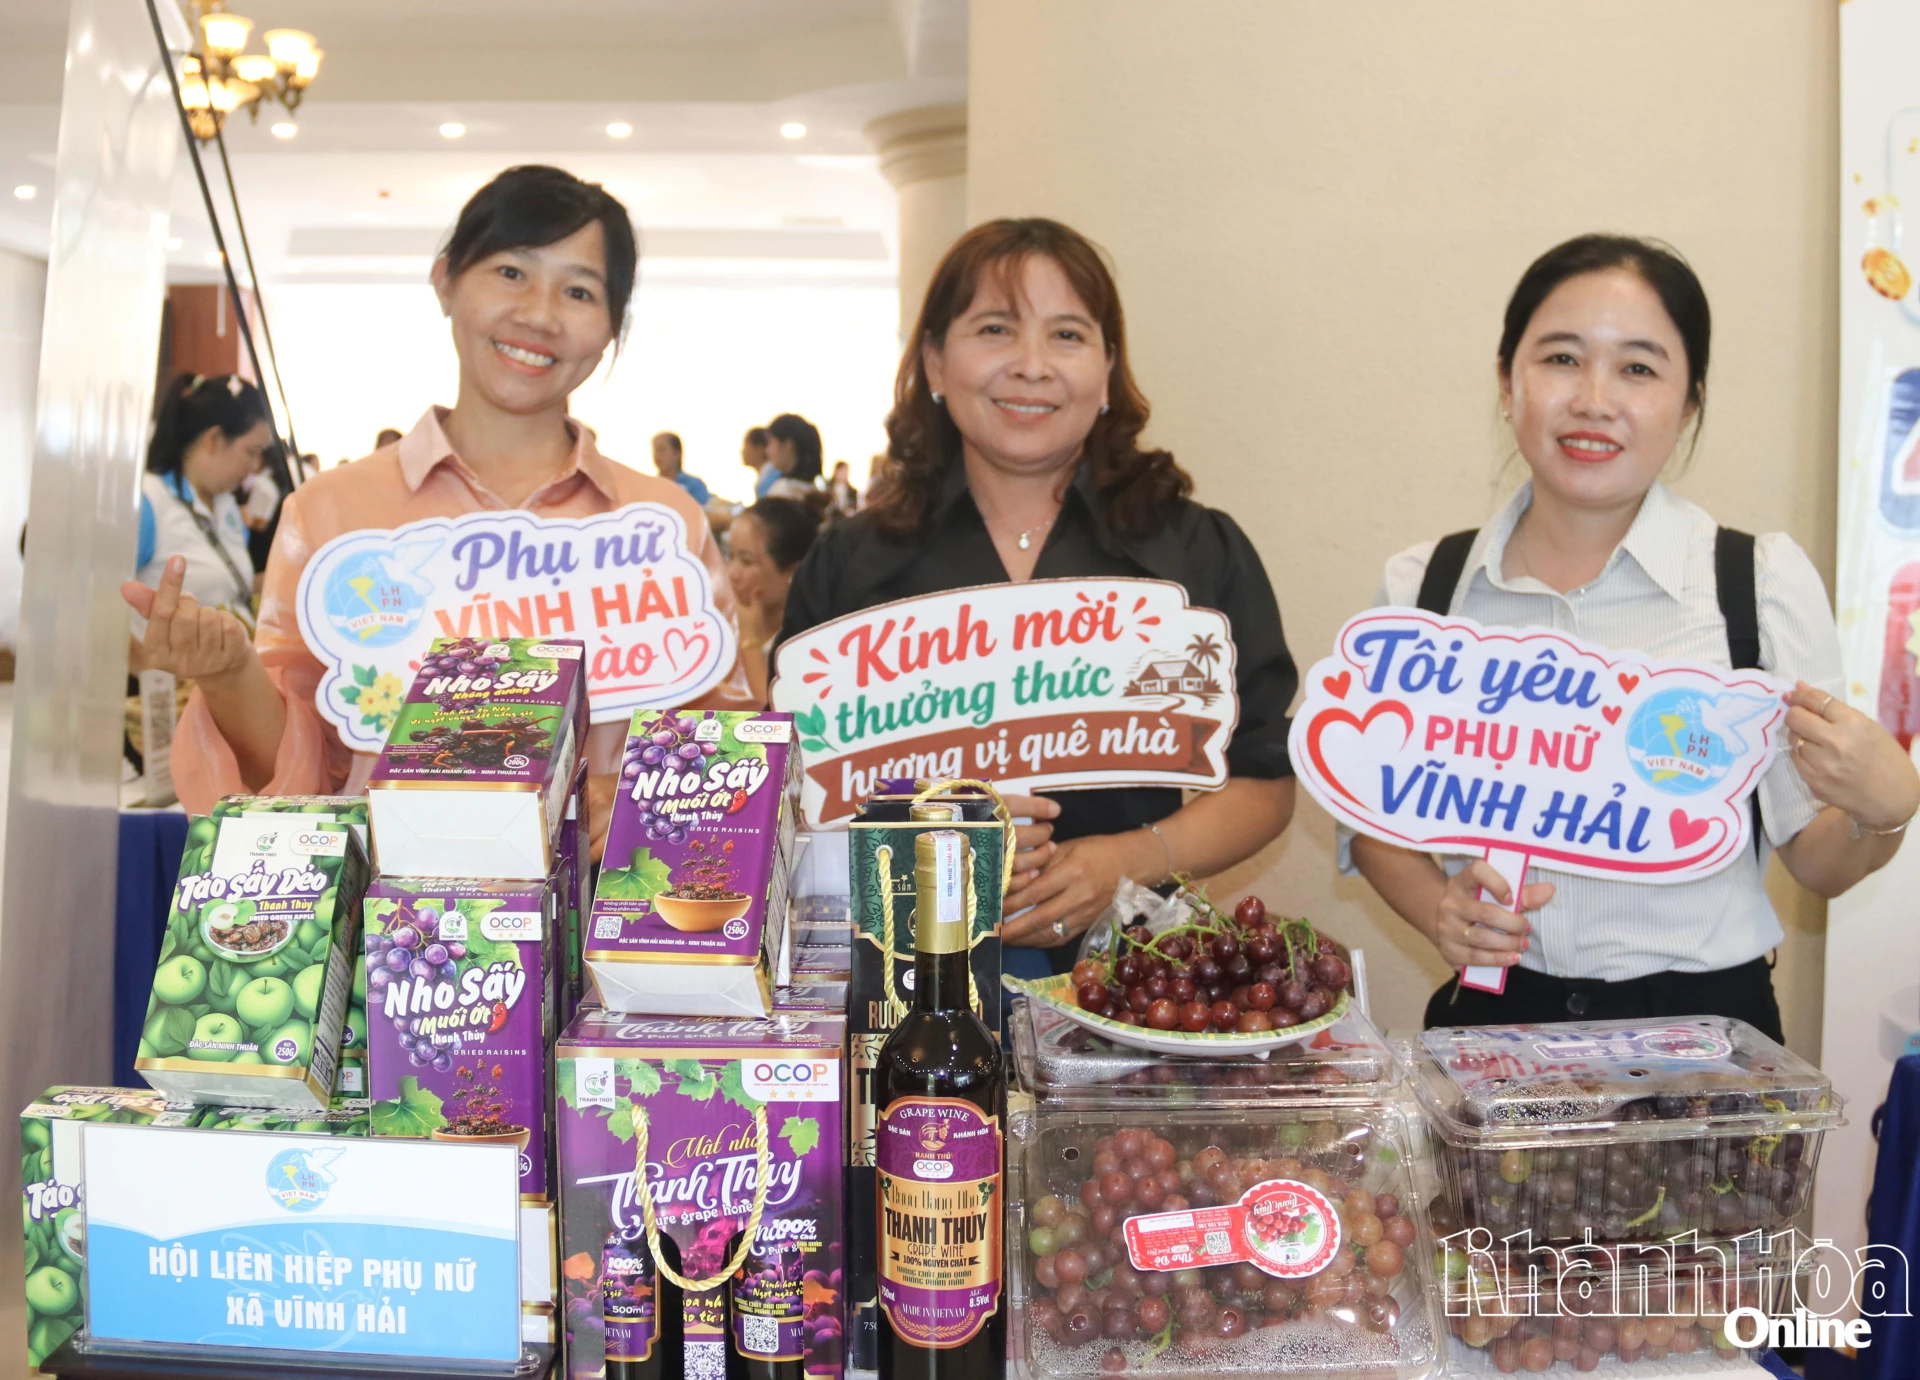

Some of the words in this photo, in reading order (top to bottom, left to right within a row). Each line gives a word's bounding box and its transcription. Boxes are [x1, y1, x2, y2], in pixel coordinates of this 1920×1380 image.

[451, 530, 580, 593] Phụ
[596, 523, 667, 569] nữ
[434, 590, 577, 639] VĨNH
[591, 568, 690, 628] HẢI
[838, 603, 997, 688] Kính
[1011, 590, 1124, 650] mời
[588, 633, 660, 681] ào
[1353, 629, 1463, 694] Tôi
[1477, 649, 1602, 714] yêu
[423, 676, 492, 696] Nho
[493, 669, 559, 692] Sấy
[452, 690, 490, 700] Không
[493, 687, 531, 697] đường
[834, 678, 996, 743] thưởng
[1011, 656, 1115, 704] thức
[743, 724, 782, 733] OCOP
[1424, 714, 1518, 772] PHỤ
[1528, 724, 1602, 773] NỮ
[841, 744, 963, 803] hương
[975, 729, 1012, 776] vị
[1018, 717, 1091, 766] quê
[1098, 714, 1180, 756] nhà
[1679, 761, 1704, 776] NAM
[631, 768, 701, 801] Nho
[703, 758, 770, 796] Sấy
[660, 792, 710, 815] Muối
[710, 788, 732, 808] Ớt
[1380, 759, 1527, 832] VĨNH
[1532, 782, 1652, 853] HẢI
[670, 810, 699, 822] Thanh
[701, 809, 723, 822] Thủy
[299, 834, 338, 846] OCOP
[180, 871, 227, 910] Táo
[226, 859, 279, 904] Sấy
[277, 864, 328, 896] Dẻo
[259, 901, 287, 911] Thanh
[291, 899, 313, 912] Thủy
[490, 917, 532, 928] OCOP
[727, 925, 745, 935] 250G
[384, 976, 455, 1018] Nho
[458, 962, 526, 1010] Sấy
[419, 1008, 467, 1036] Muối
[470, 1002, 491, 1026] Ớt
[189, 1039, 204, 1048] ĐẶC
[204, 1040, 217, 1049] SẢN
[219, 1042, 235, 1050] NINH
[236, 1043, 258, 1052] THUẬN
[430, 1032, 460, 1045] Thanh
[462, 1031, 486, 1044] Thủy
[277, 1047, 294, 1056] 250G
[754, 1063, 828, 1082] OCOP
[899, 1107, 936, 1119] GRAPE
[938, 1108, 970, 1122] WINE
[898, 1127, 911, 1136] SẢN
[953, 1129, 976, 1139] KHÁNH
[976, 1127, 989, 1136] HÒA
[661, 1123, 740, 1169] Mật
[912, 1151, 935, 1159] THANH
[916, 1161, 950, 1171] OCOP
[29, 1178, 73, 1219] Táo
[300, 1191, 315, 1199] NAM
[576, 1160, 716, 1240] Thanh
[656, 1215, 676, 1226] ure
[681, 1209, 719, 1226] grape
[723, 1202, 755, 1217] hone
[772, 1218, 817, 1233] 100%
[885, 1206, 937, 1245] THANH
[941, 1211, 987, 1245] THỦY
[907, 1243, 936, 1258] GRAPE
[941, 1244, 964, 1258] WINE
[1169, 1251, 1194, 1263] Nho
[149, 1242, 199, 1284] HỘI
[210, 1245, 273, 1283] LIÊN
[284, 1247, 354, 1293] HIỆP
[363, 1258, 422, 1296] PHỤ
[434, 1256, 477, 1293] NỮ
[608, 1257, 643, 1270] 100%
[903, 1255, 922, 1266] 100%
[923, 1256, 949, 1268] NGUYÊN
[950, 1256, 967, 1267] CHẤT
[1153, 1255, 1170, 1268] Đỏ
[752, 1287, 773, 1299] Ngọt
[881, 1284, 896, 1301] 750ml
[969, 1294, 990, 1308] 8.5Vol
[226, 1290, 263, 1327] XÃ
[273, 1294, 345, 1333] VĨNH
[356, 1294, 407, 1335] HẢI
[612, 1305, 644, 1314] 500ml
[902, 1303, 921, 1316] MADE
[923, 1307, 932, 1317] IN
[931, 1307, 965, 1319] VIETNAM
